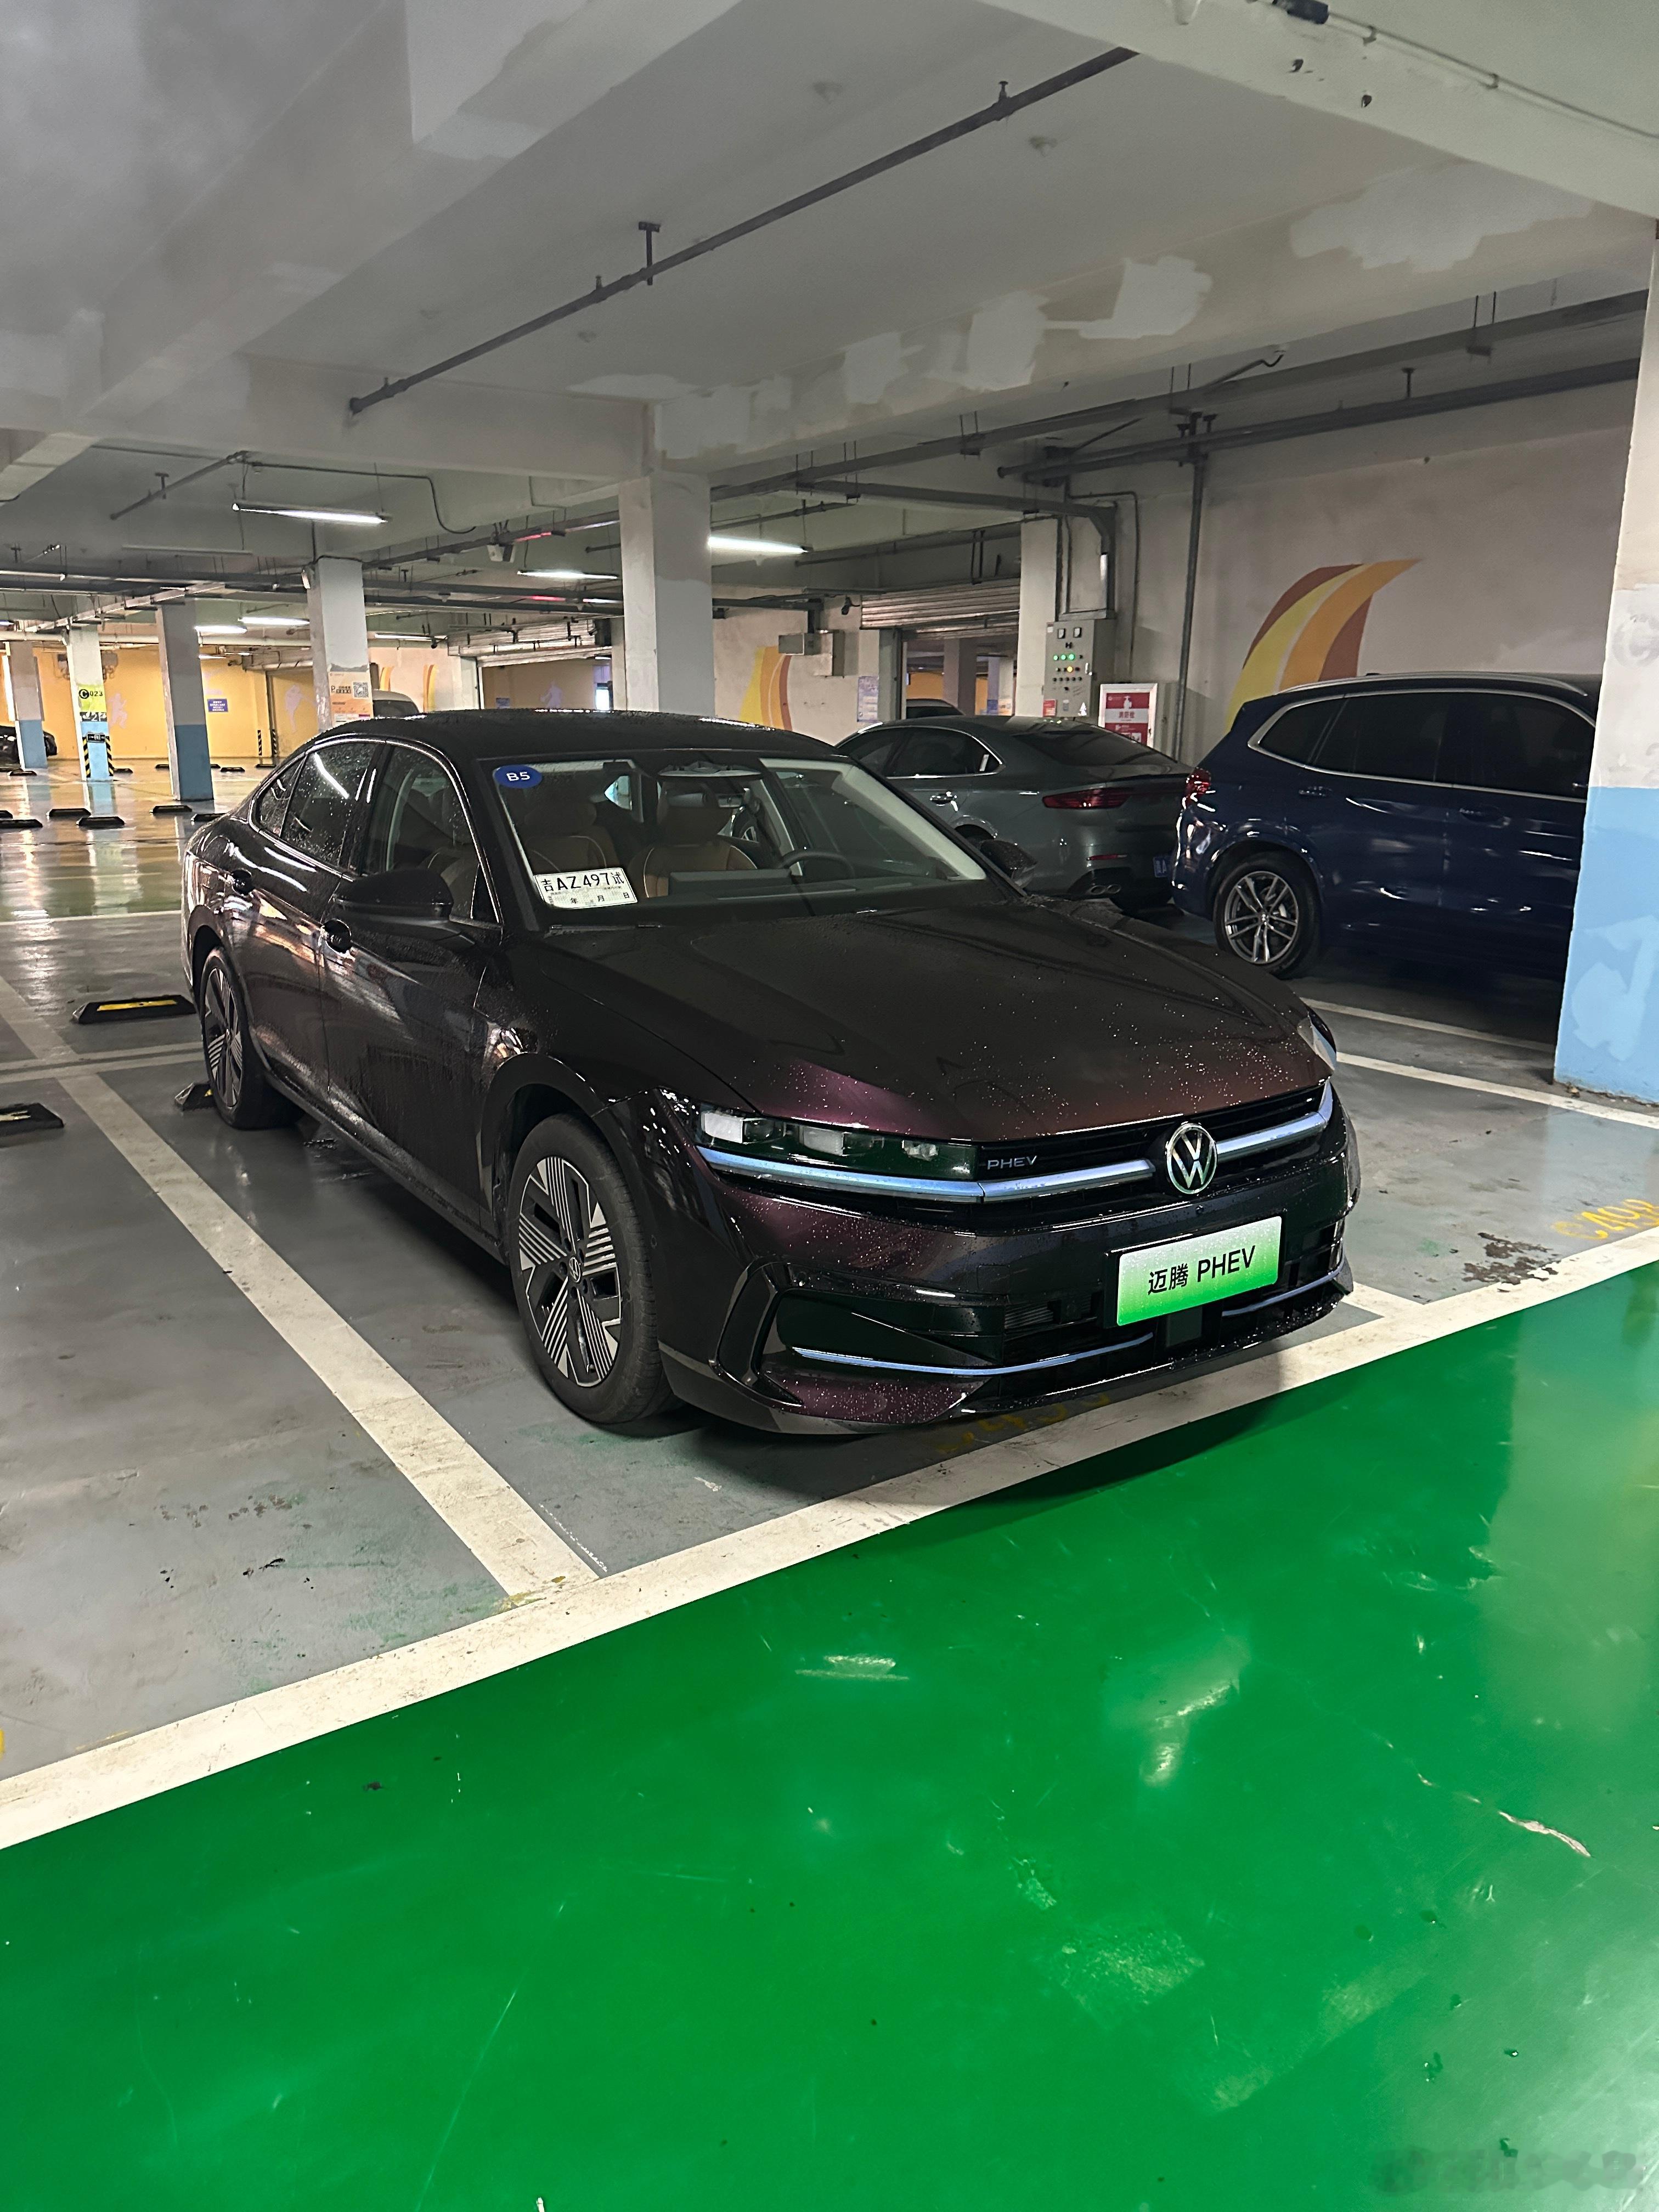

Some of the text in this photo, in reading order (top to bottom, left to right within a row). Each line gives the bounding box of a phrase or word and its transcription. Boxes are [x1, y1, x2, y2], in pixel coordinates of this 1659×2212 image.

[506, 771, 530, 781] B5
[988, 1155, 1037, 1170] PHEV
[1148, 1245, 1255, 1295] 迈腾 PHEV
